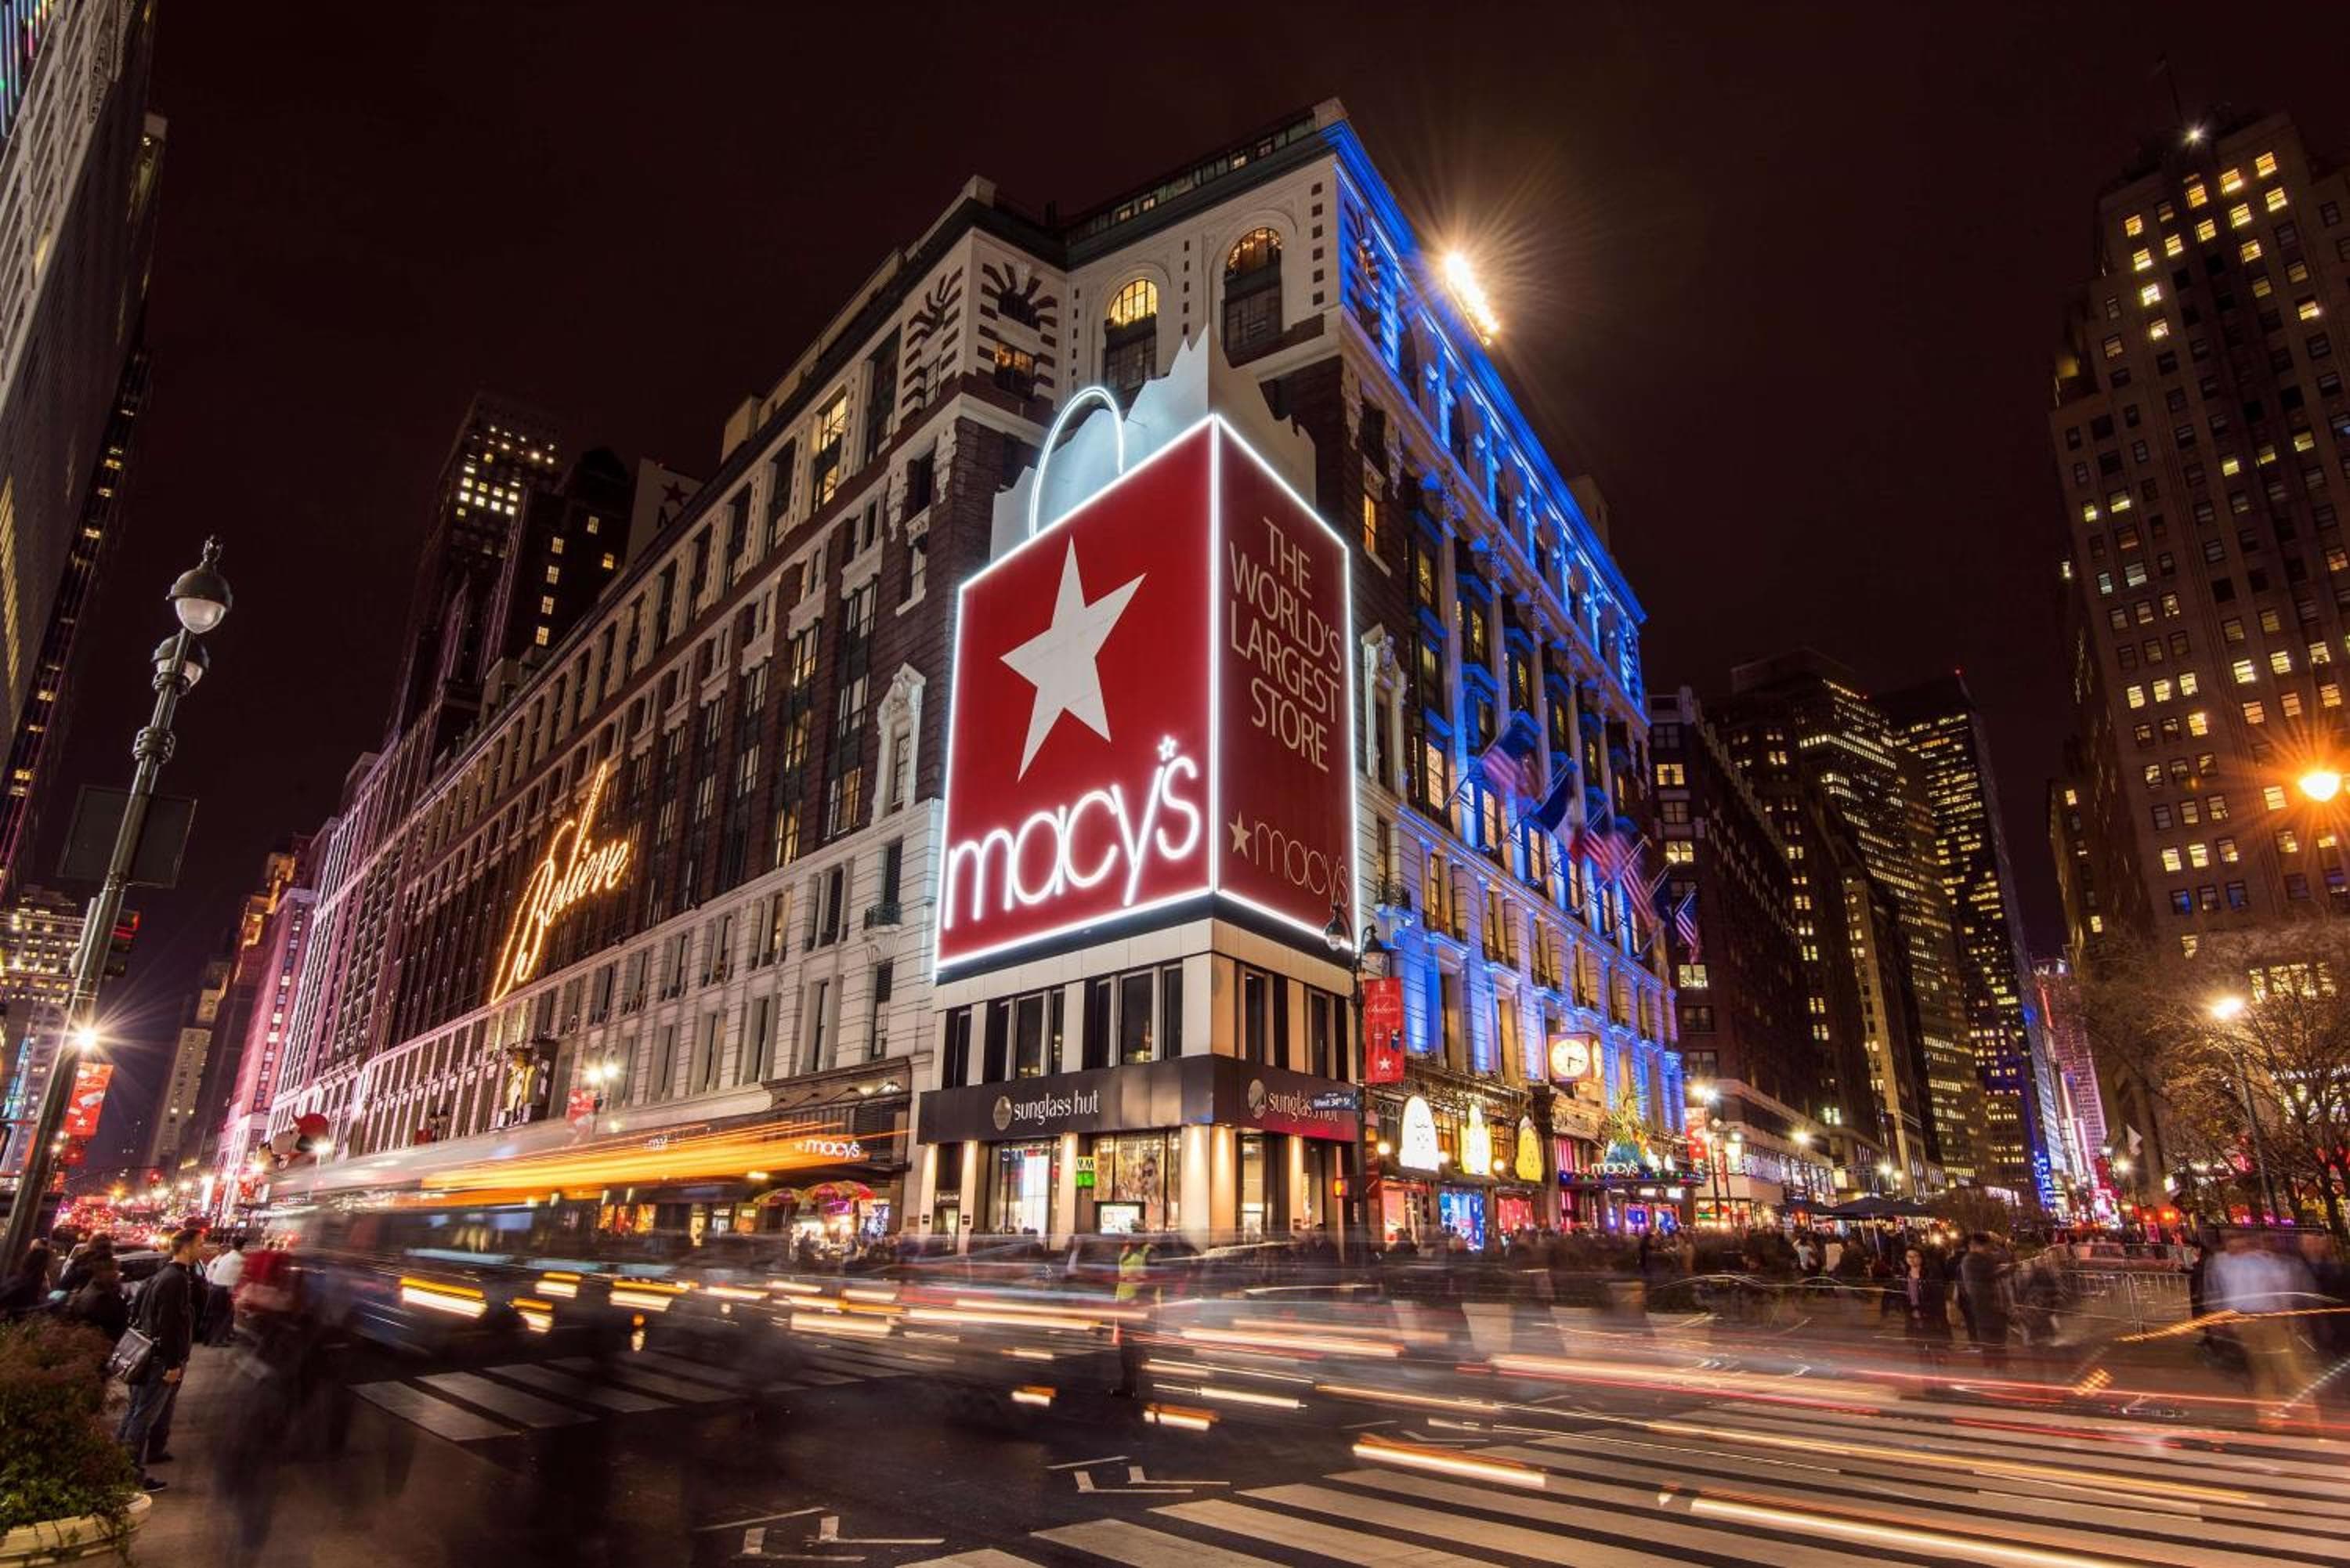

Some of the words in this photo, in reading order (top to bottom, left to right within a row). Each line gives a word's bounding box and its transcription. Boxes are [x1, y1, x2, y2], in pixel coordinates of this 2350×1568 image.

[1264, 516, 1312, 599] THE
[1230, 540, 1341, 674] WORLD'S
[1231, 599, 1340, 723] LARGEST
[1252, 677, 1329, 773] STORE
[942, 734, 1202, 930] macy's
[1255, 821, 1350, 913] macy's
[490, 762, 629, 1005] Believe
[804, 1140, 859, 1160] macy's
[1014, 1093, 1072, 1125] sunglass
[1074, 1089, 1099, 1115] hut
[1268, 1090, 1318, 1122] sunglas
[1591, 1159, 1639, 1175] macy's
